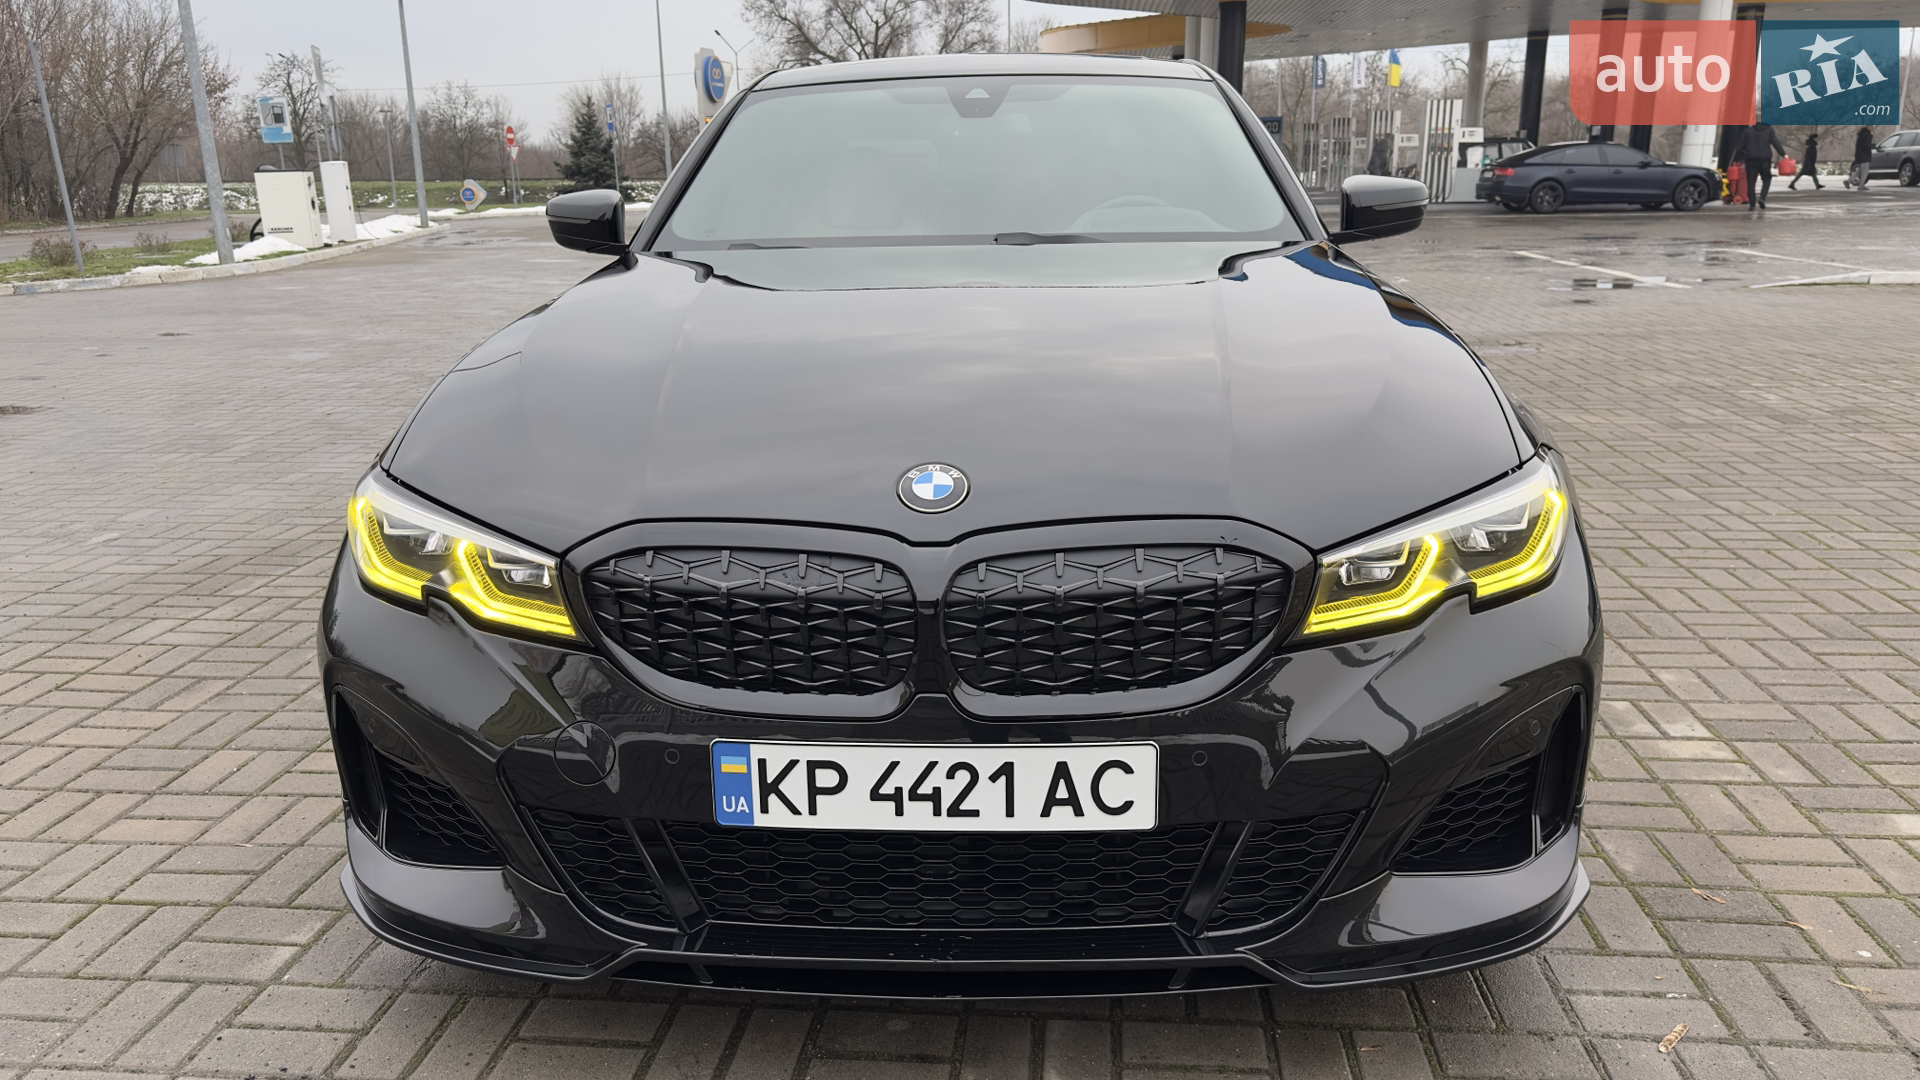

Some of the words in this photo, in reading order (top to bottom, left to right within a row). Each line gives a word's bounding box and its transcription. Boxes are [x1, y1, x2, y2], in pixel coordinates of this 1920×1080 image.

[907, 465, 962, 479] BMW
[757, 758, 848, 816] KP
[869, 761, 1015, 818] 4421
[1040, 759, 1135, 818] AC
[722, 795, 750, 813] UA
